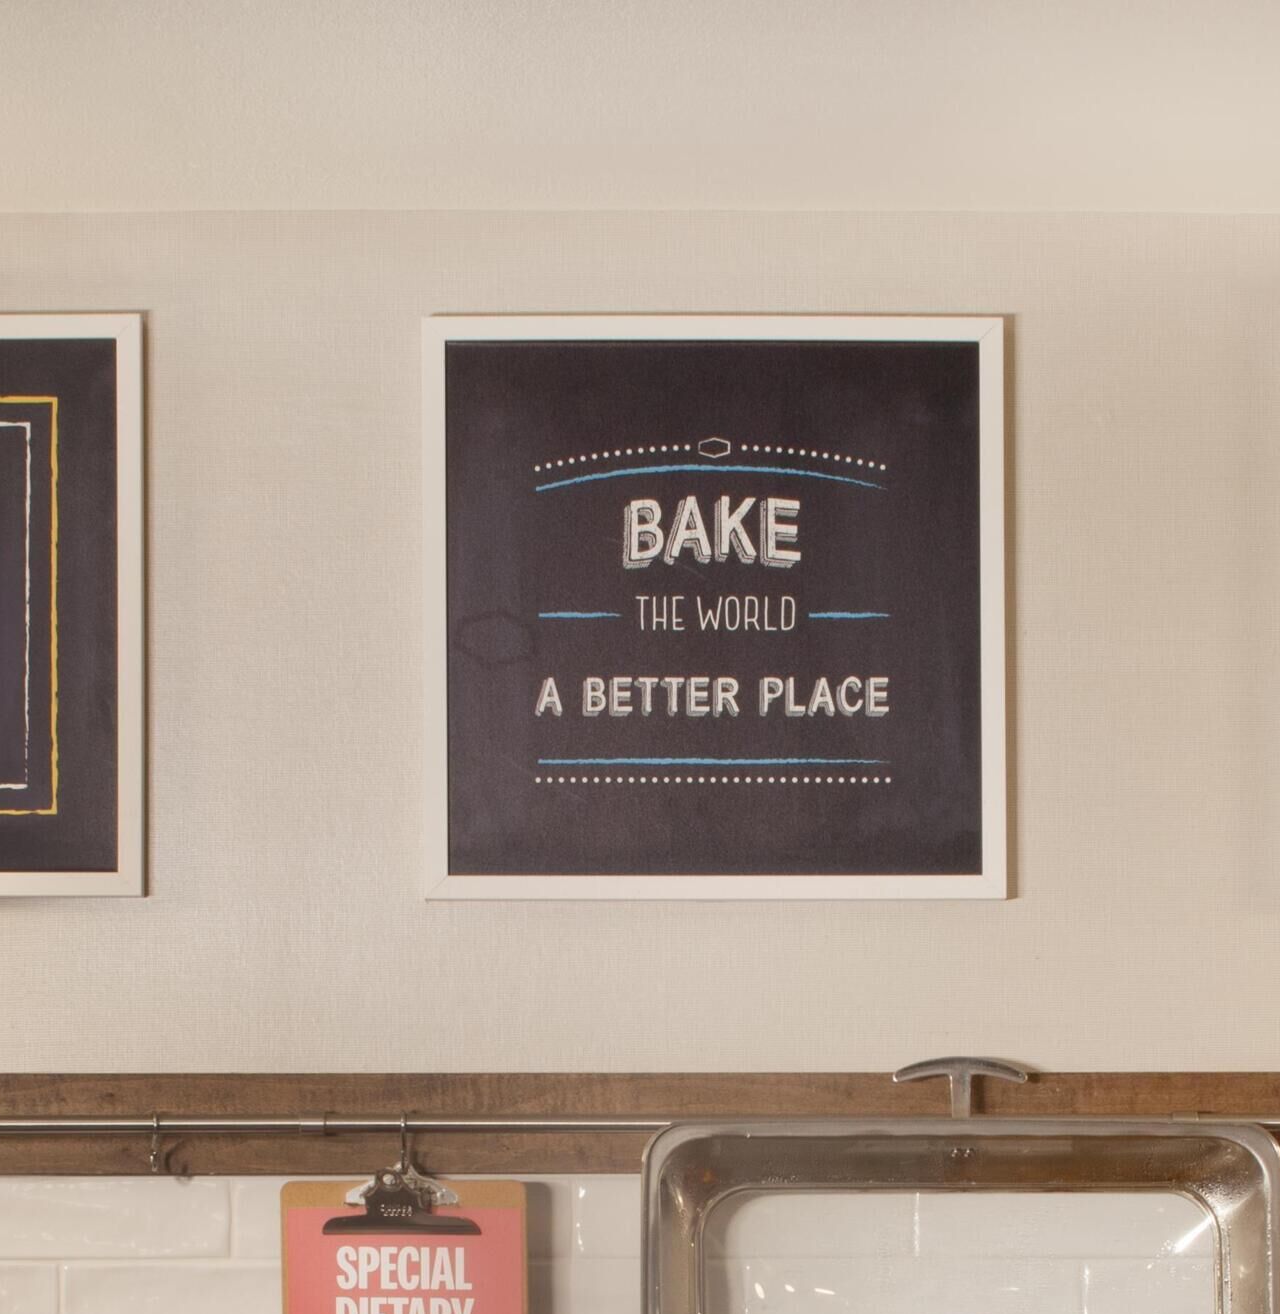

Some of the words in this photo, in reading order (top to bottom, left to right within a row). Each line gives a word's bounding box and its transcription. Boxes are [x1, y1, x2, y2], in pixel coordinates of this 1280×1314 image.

[622, 495, 802, 569] BAKE
[635, 596, 685, 631] THE
[696, 596, 796, 631] WORLD
[534, 676, 562, 717] A
[582, 676, 740, 717] BETTER
[759, 676, 890, 717] PLACE
[336, 1245, 473, 1291] SPECIAL
